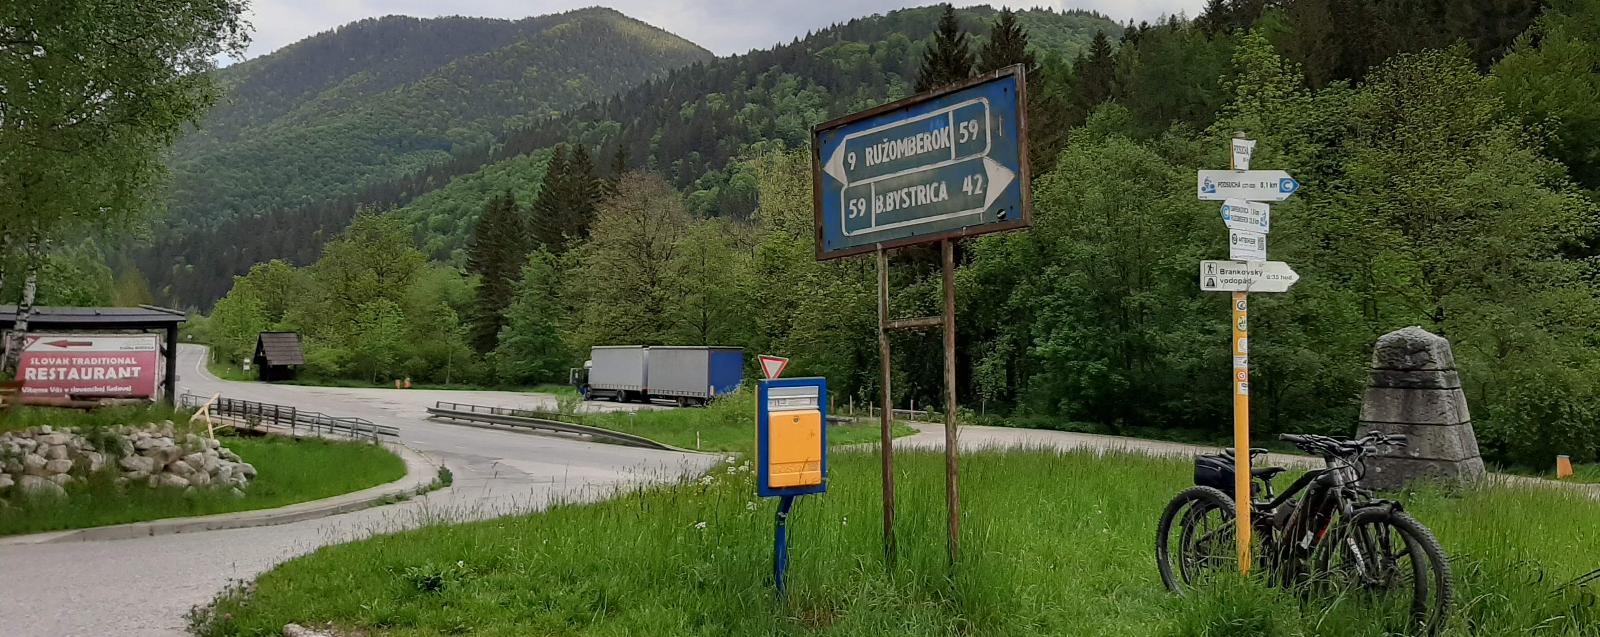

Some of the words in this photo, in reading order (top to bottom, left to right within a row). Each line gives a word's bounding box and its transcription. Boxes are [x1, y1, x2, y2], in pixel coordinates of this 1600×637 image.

[959, 120, 979, 144] 59
[847, 152, 857, 170] 9
[865, 127, 951, 167] RUŽOMBEROK
[875, 182, 949, 214] B.BYSTRICA
[962, 174, 983, 196] 42
[848, 198, 866, 219] 59
[1219, 268, 1263, 277] Brankovský
[1219, 277, 1252, 285] vodopád
[30, 357, 70, 365] SLOVAK
[71, 357, 137, 365] TRADITIONAL
[24, 366, 142, 381] RESTAURANT
